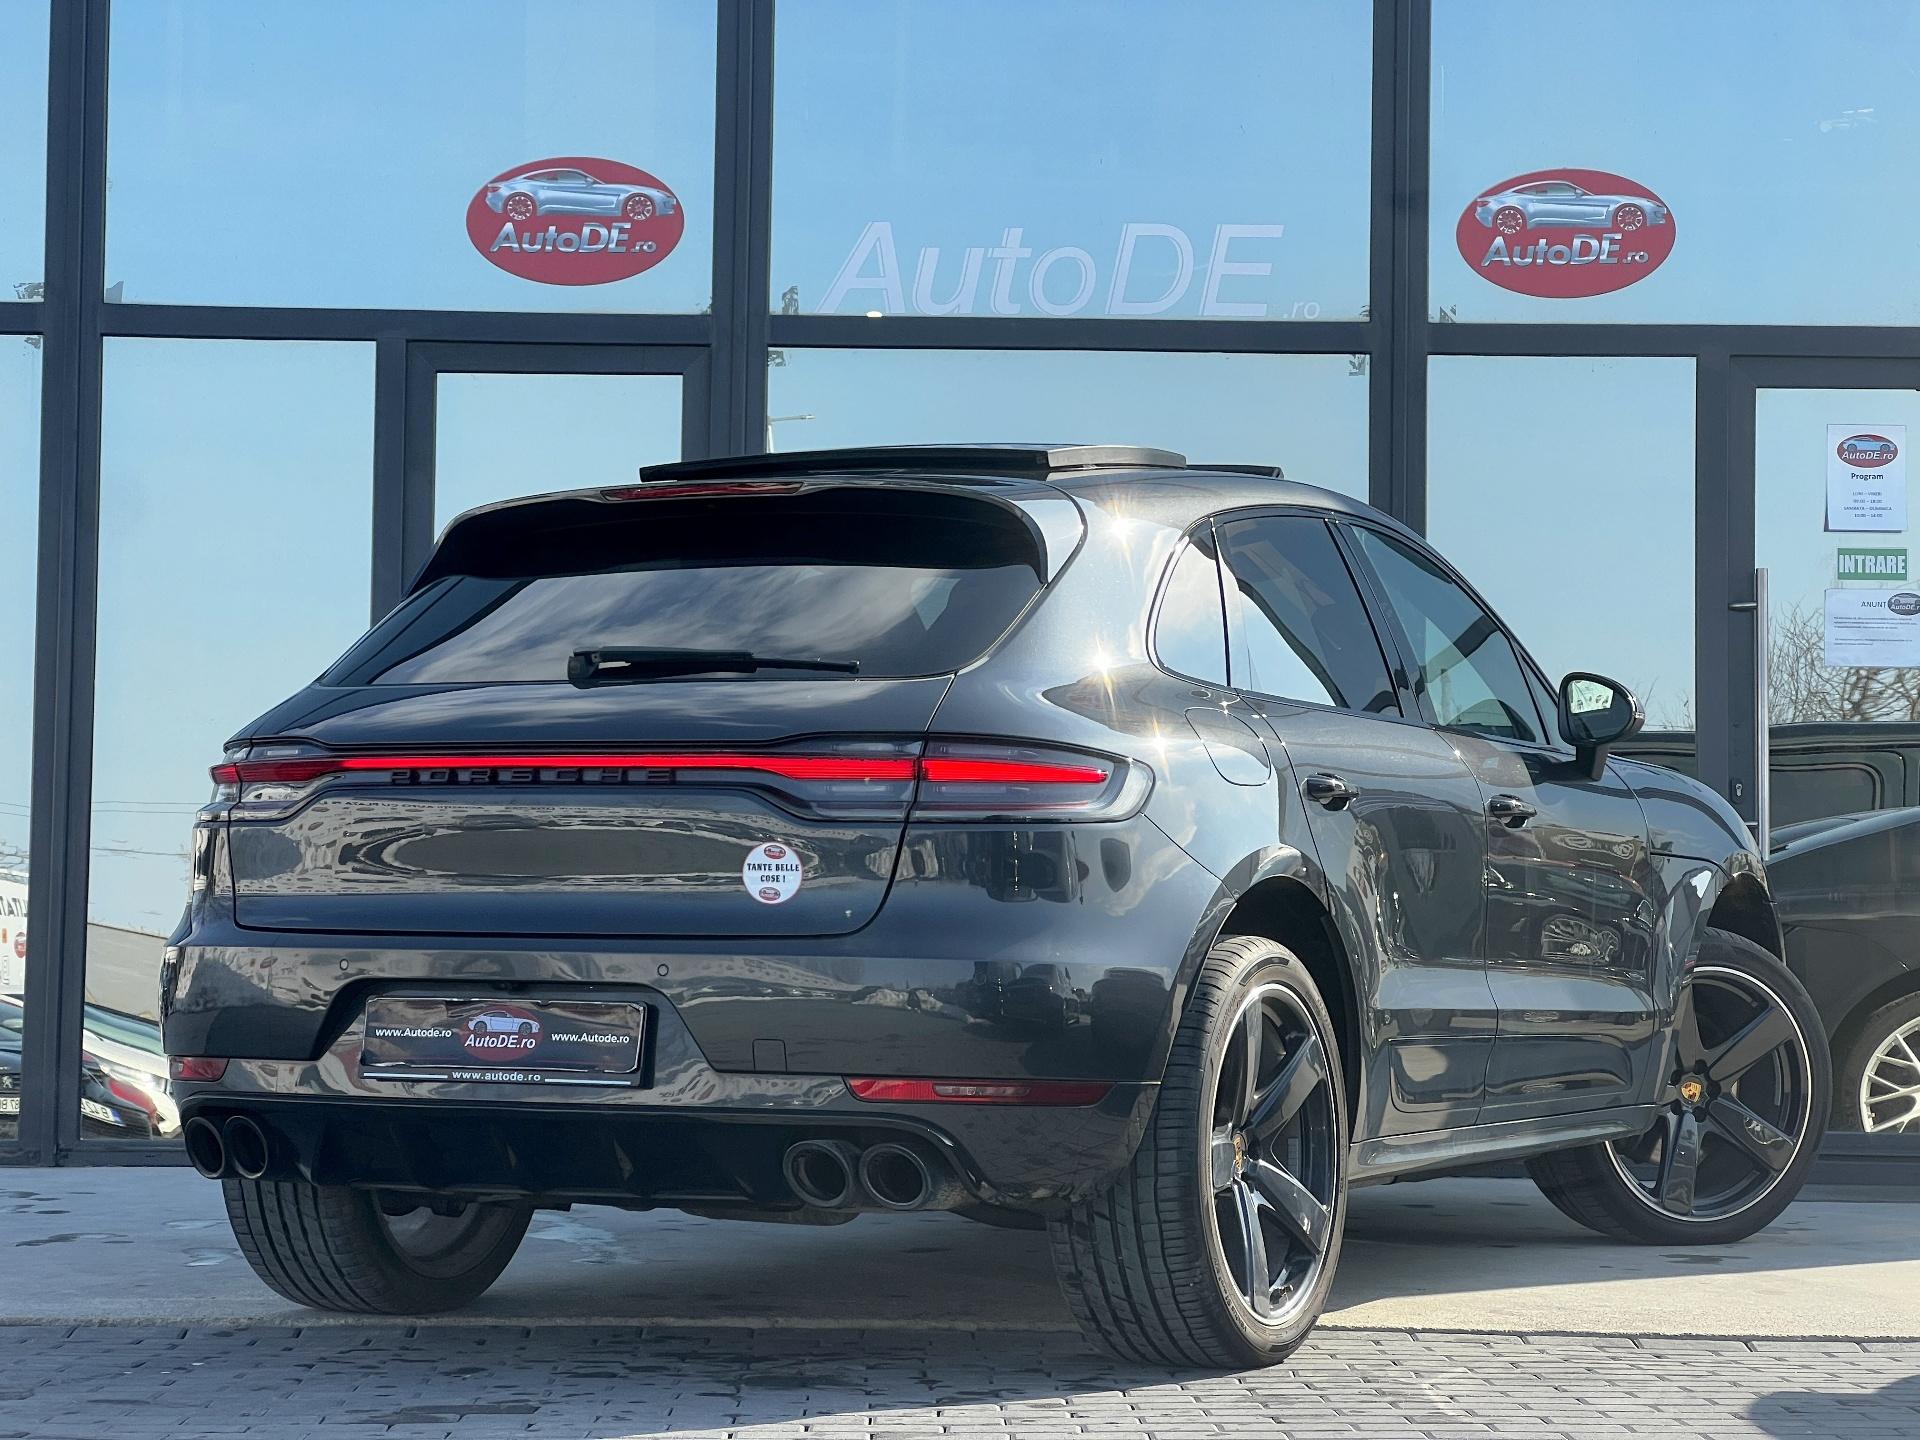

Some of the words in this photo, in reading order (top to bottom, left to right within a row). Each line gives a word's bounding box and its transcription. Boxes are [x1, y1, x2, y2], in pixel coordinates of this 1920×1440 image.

[489, 222, 657, 254] AutoDE.ro
[1481, 232, 1649, 268] AutoDE.ro
[1841, 451, 1894, 460] AutoDE.ro
[1851, 472, 1884, 481] Program
[1839, 554, 1906, 574] INTRARE
[390, 767, 673, 785] PORSCHE
[746, 863, 773, 871] TANTE
[775, 863, 800, 872] BELLE
[760, 874, 781, 883] COSE
[375, 1027, 452, 1037] www.Autode.ro
[464, 1033, 536, 1049] AutoDE.ro
[551, 1032, 630, 1044] www.Autode.ro
[452, 1071, 541, 1082] www.autode.ro
